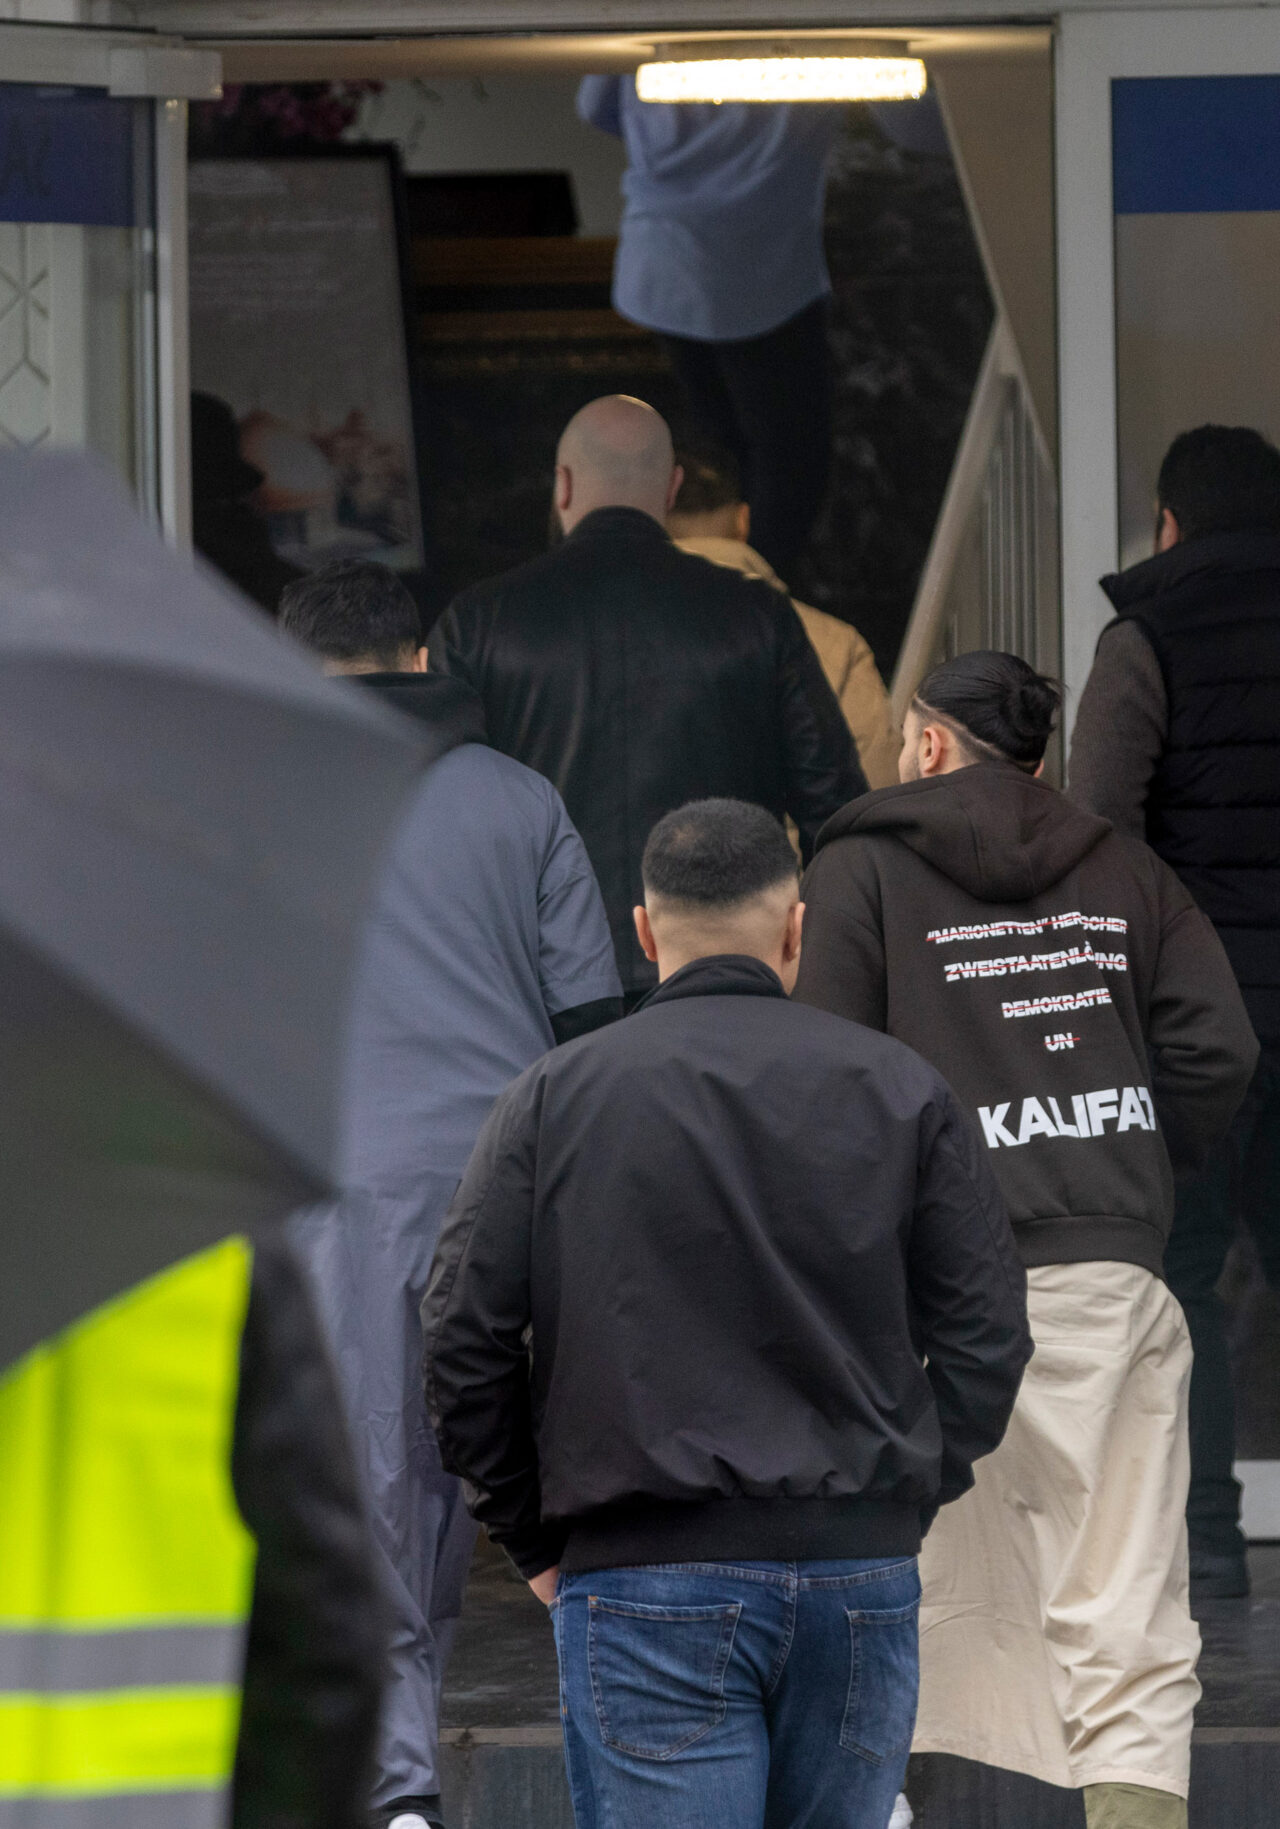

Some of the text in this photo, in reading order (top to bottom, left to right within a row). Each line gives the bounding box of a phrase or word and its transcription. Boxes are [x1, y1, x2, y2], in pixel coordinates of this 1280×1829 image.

[1001, 987, 1113, 1019] DEMOKRATIE
[1044, 1032, 1076, 1052] UN
[977, 1086, 1157, 1149] KALIFAT
